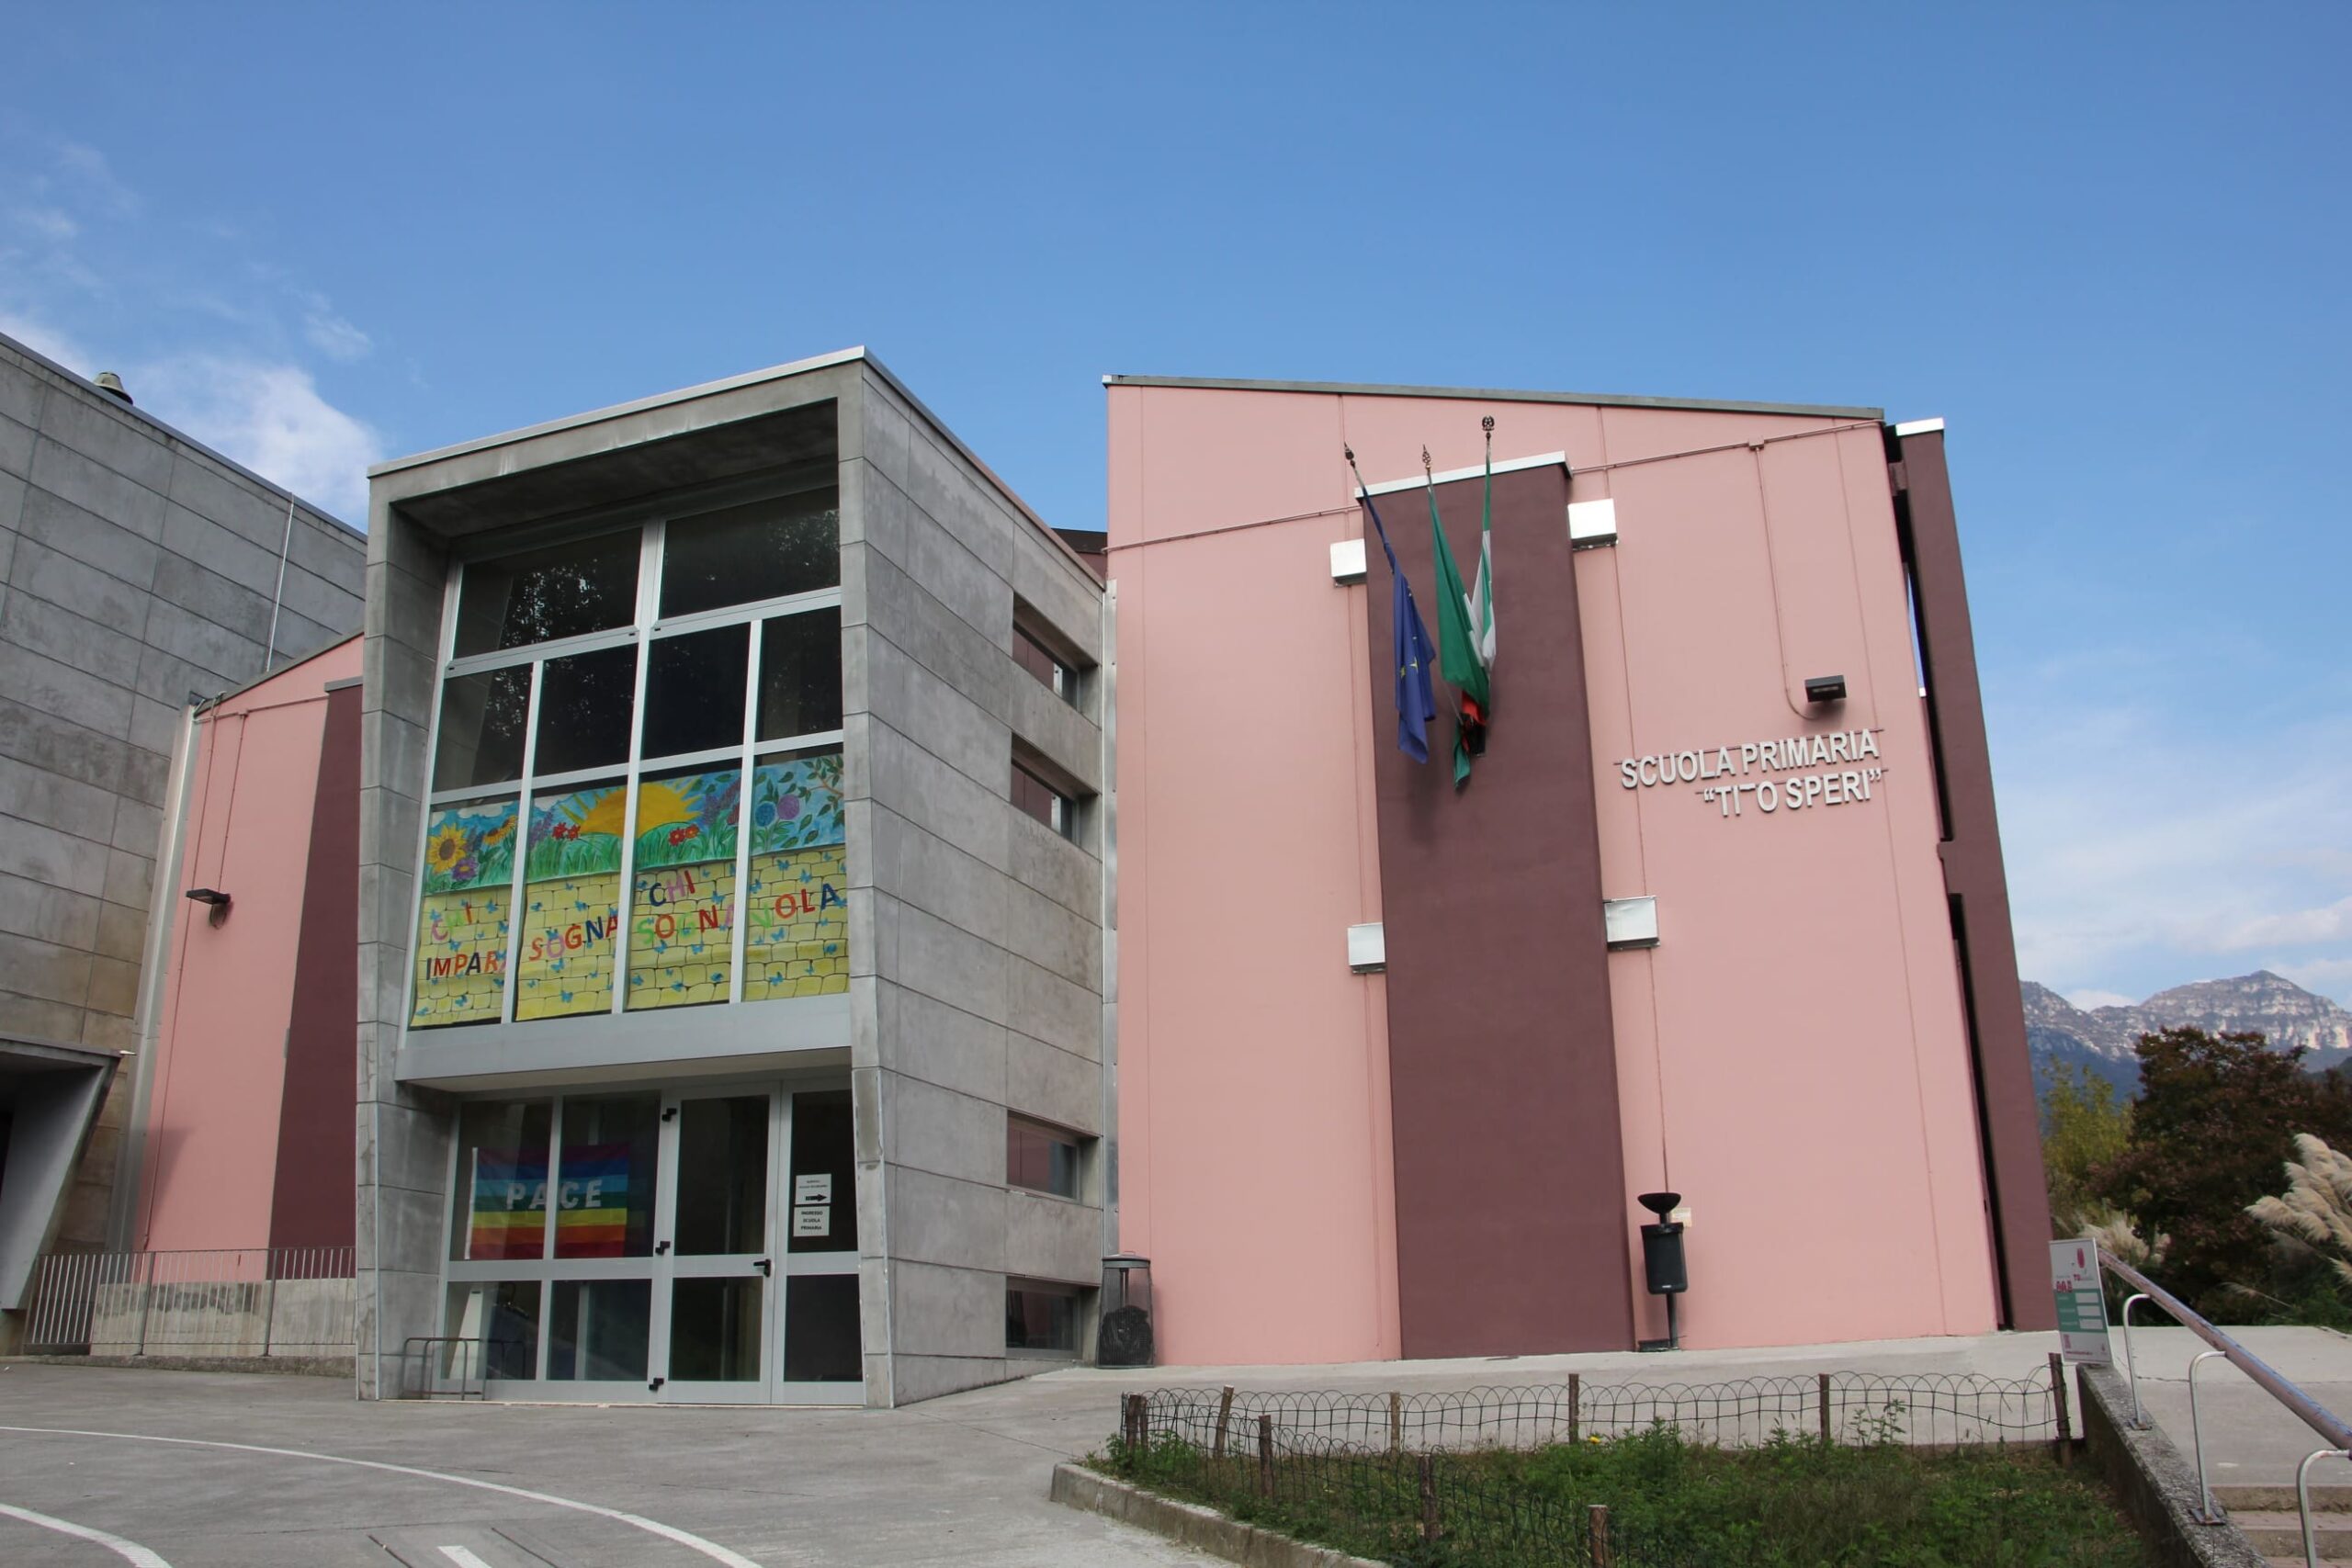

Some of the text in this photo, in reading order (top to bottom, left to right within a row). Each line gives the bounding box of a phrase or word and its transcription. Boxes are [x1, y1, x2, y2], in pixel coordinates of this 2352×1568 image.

[1621, 728, 1880, 789] SCUOLA PRIMARIA
[649, 870, 695, 908] CHI
[750, 883, 843, 929] VOLA
[430, 902, 472, 941] CHI
[506, 1178, 603, 1211] PACE
